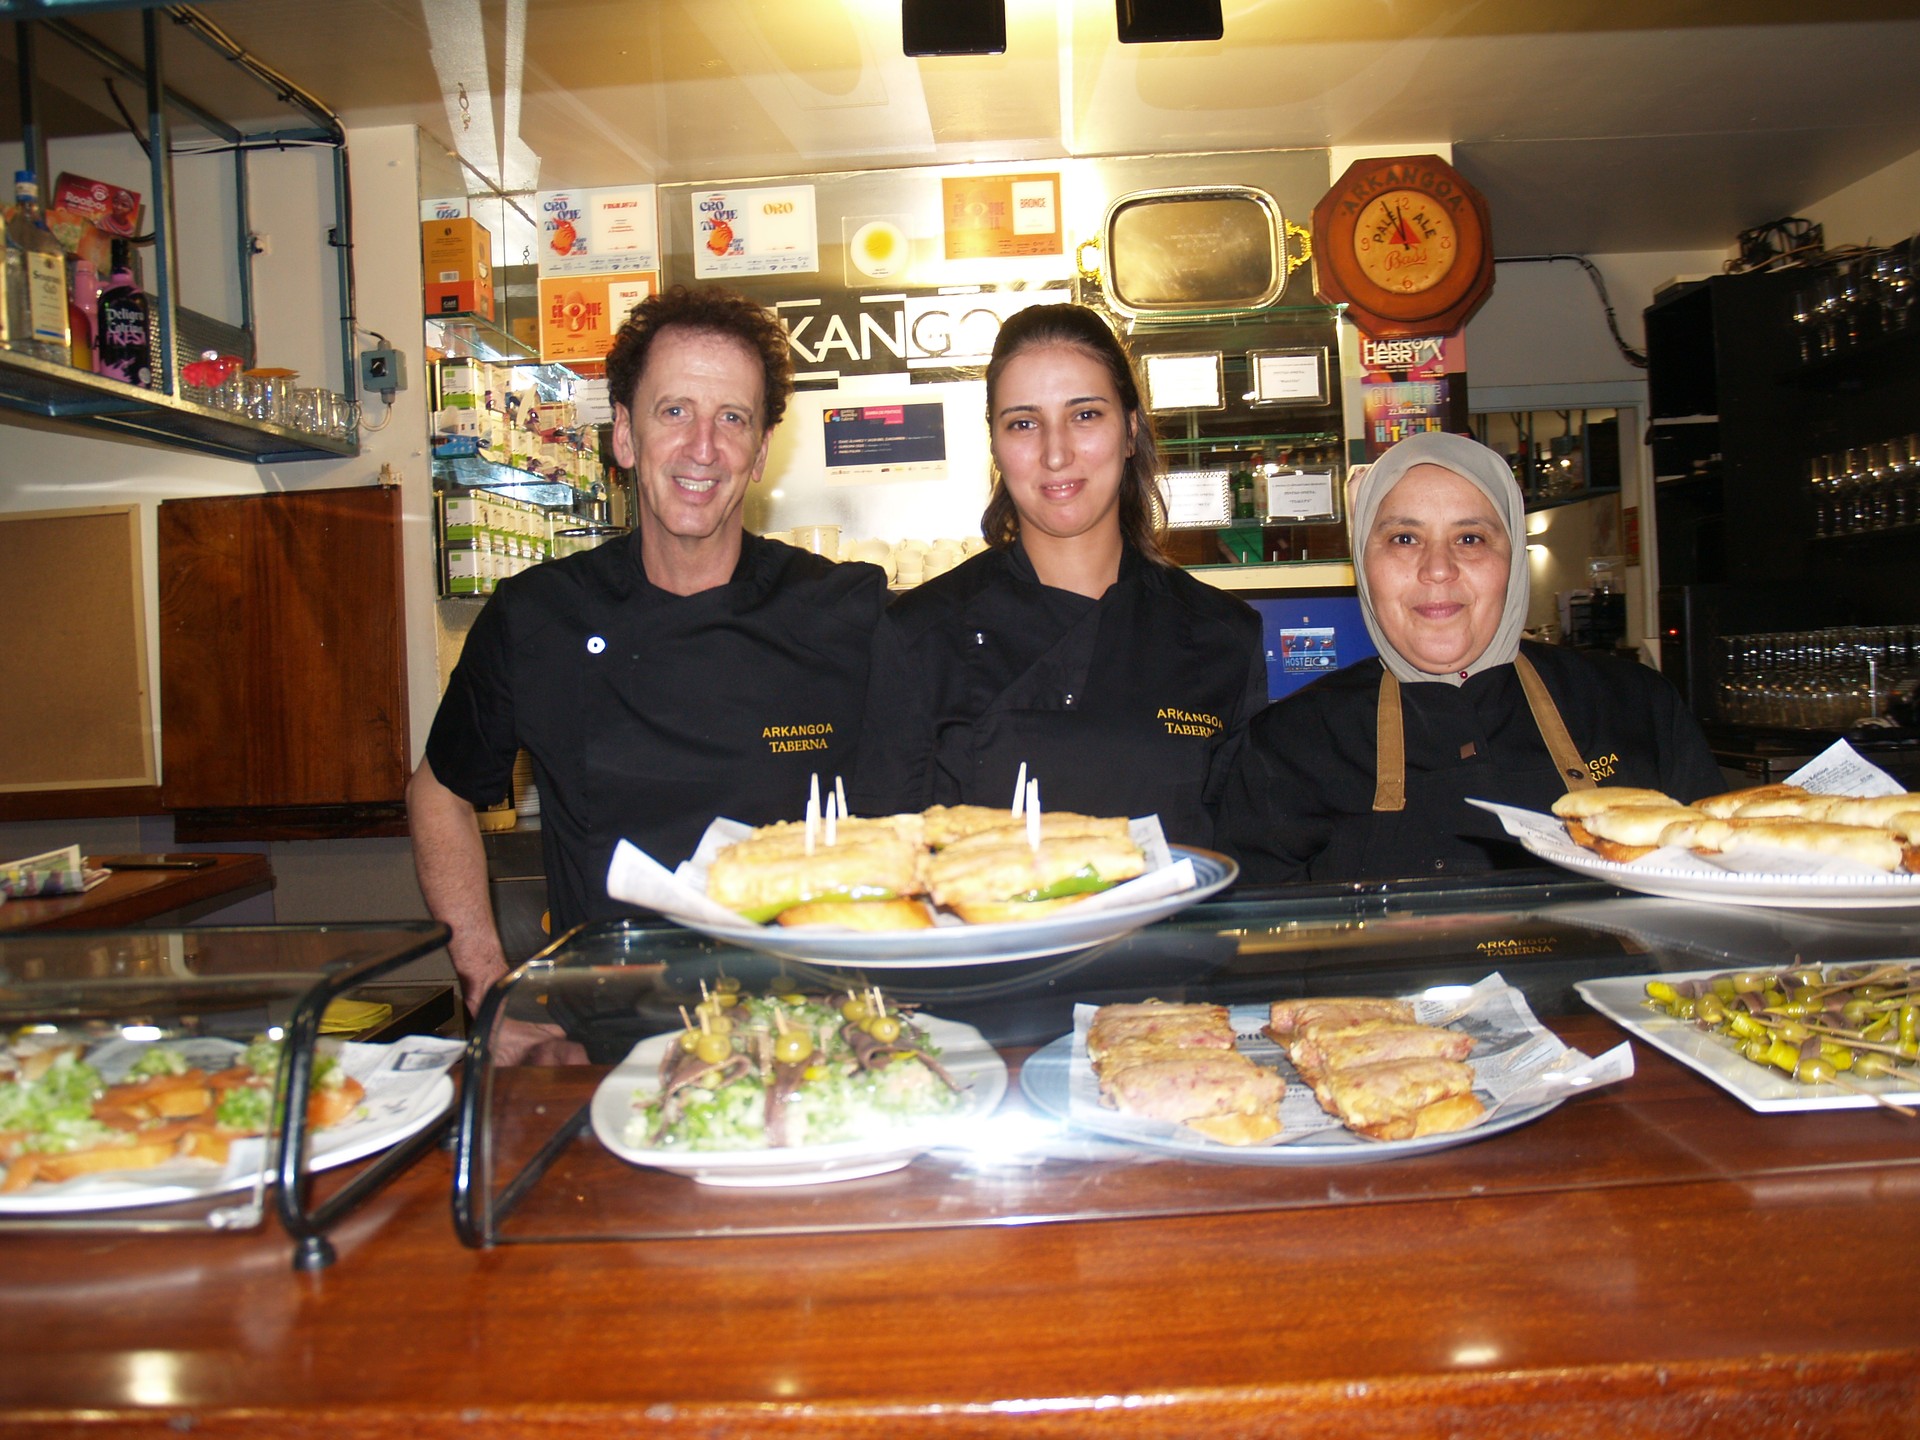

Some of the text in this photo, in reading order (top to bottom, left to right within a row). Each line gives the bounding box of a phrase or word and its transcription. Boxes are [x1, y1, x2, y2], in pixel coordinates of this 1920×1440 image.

[1344, 166, 1463, 214] ARKANGOA
[65, 191, 107, 212] Rooibos
[543, 200, 569, 212] CRO
[699, 200, 725, 212] CRO
[1395, 197, 1409, 211] 12
[763, 202, 794, 216] ORO
[1373, 211, 1437, 243] PALE ALE
[1360, 237, 1371, 251] 9
[1440, 236, 1451, 250] 3
[1384, 248, 1428, 271] Bass
[1402, 275, 1413, 289] 6
[1363, 338, 1423, 353] HARRO
[1157, 707, 1224, 731] ARKANGOA
[762, 723, 834, 738] ARKANGOA
[1164, 722, 1215, 738] TABERN
[769, 738, 829, 753] TABERNA
[1476, 936, 1558, 949] ARKANGOA
[1484, 945, 1552, 957] TABERNA
